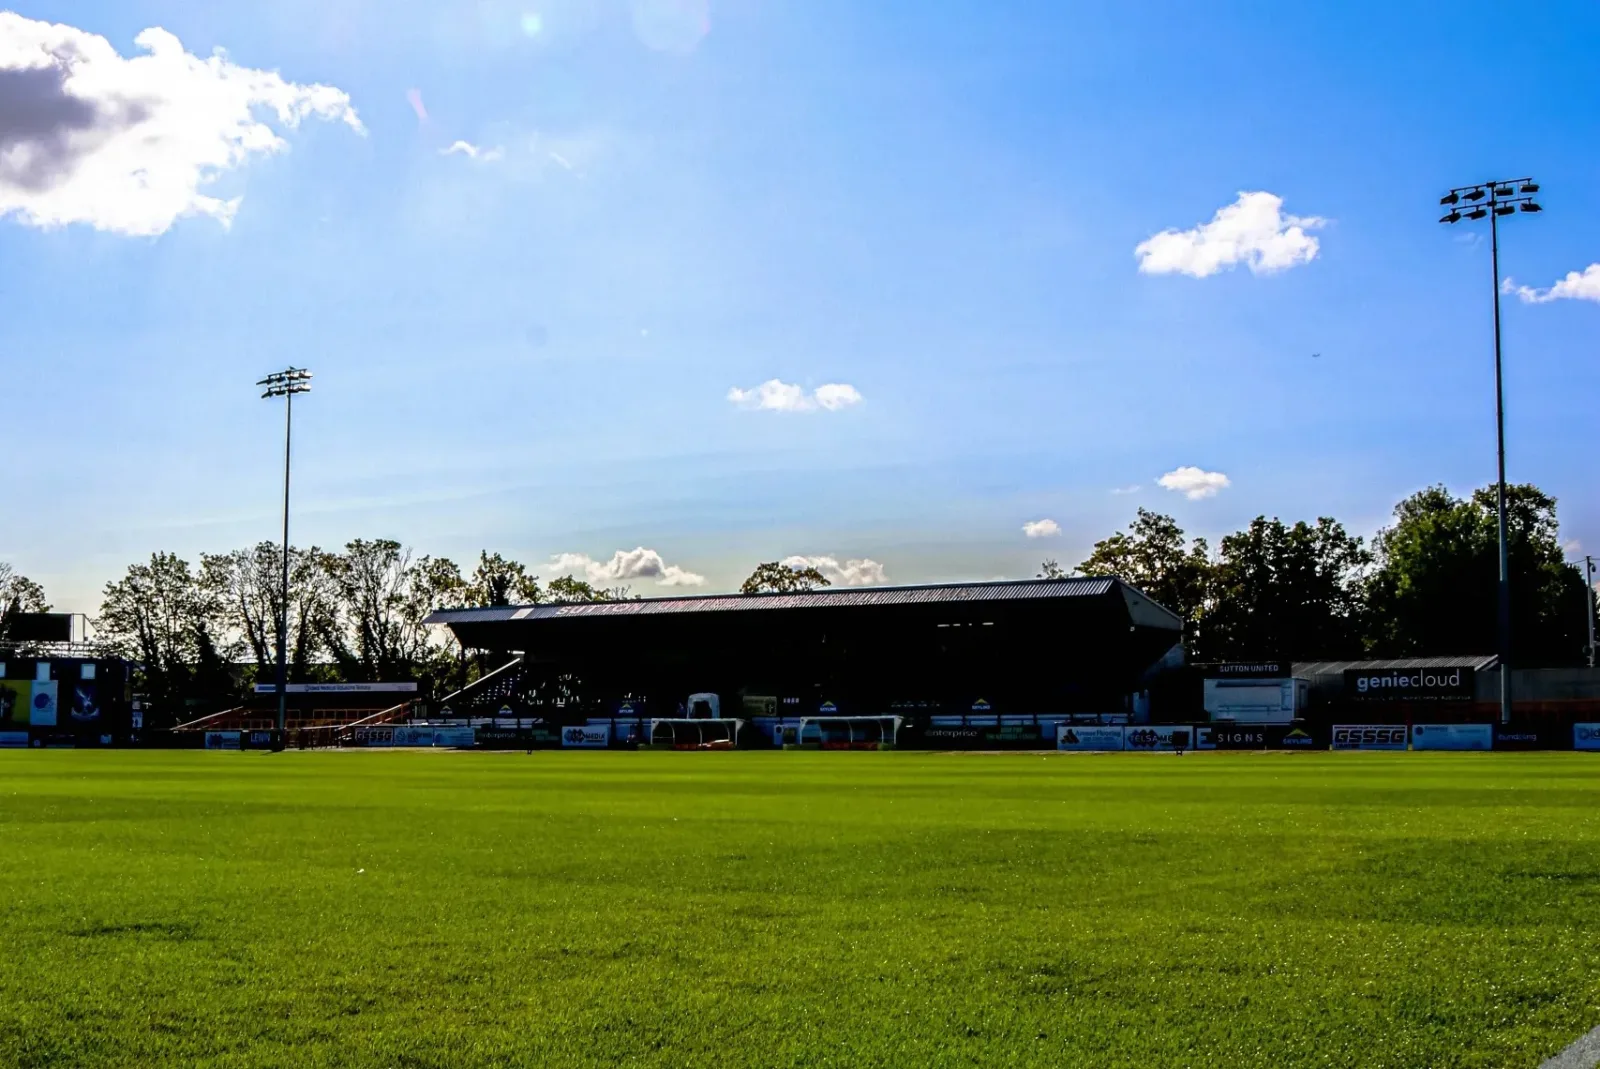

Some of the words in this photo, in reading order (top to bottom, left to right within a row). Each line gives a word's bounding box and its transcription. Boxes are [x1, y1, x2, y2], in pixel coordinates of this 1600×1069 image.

[1251, 664, 1279, 672] UNITED
[1357, 668, 1460, 692] geniecloud
[1217, 733, 1264, 743] SIGNS
[1335, 729, 1406, 744] GSSSG
